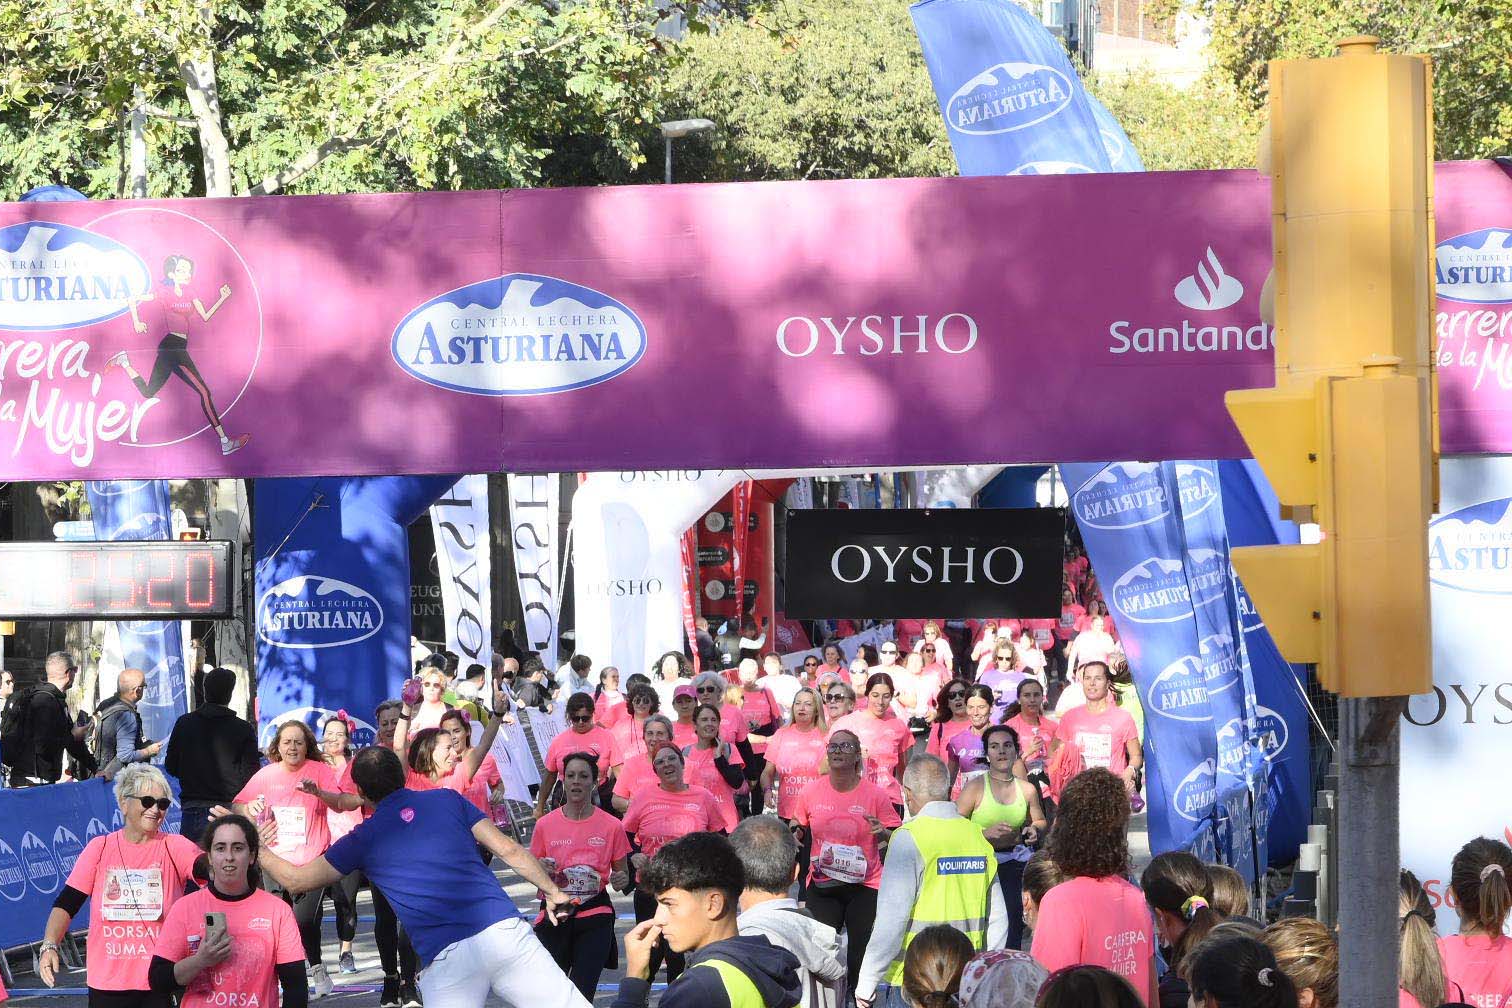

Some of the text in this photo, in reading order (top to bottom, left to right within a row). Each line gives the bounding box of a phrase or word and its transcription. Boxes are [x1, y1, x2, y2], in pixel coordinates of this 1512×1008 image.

[450, 313, 619, 330] CENTRAL LECHERA
[775, 312, 979, 357] OYSHO
[411, 321, 627, 366] ASTURIANA
[1108, 320, 1278, 354] Santand
[12, 375, 160, 468] Mujer
[831, 545, 1024, 587] OYSHO
[262, 606, 375, 632] ASTURIANA
[274, 599, 370, 610] CENTRAL LECHERA
[105, 941, 148, 956] SUMA
[206, 991, 260, 1008] DORSA
